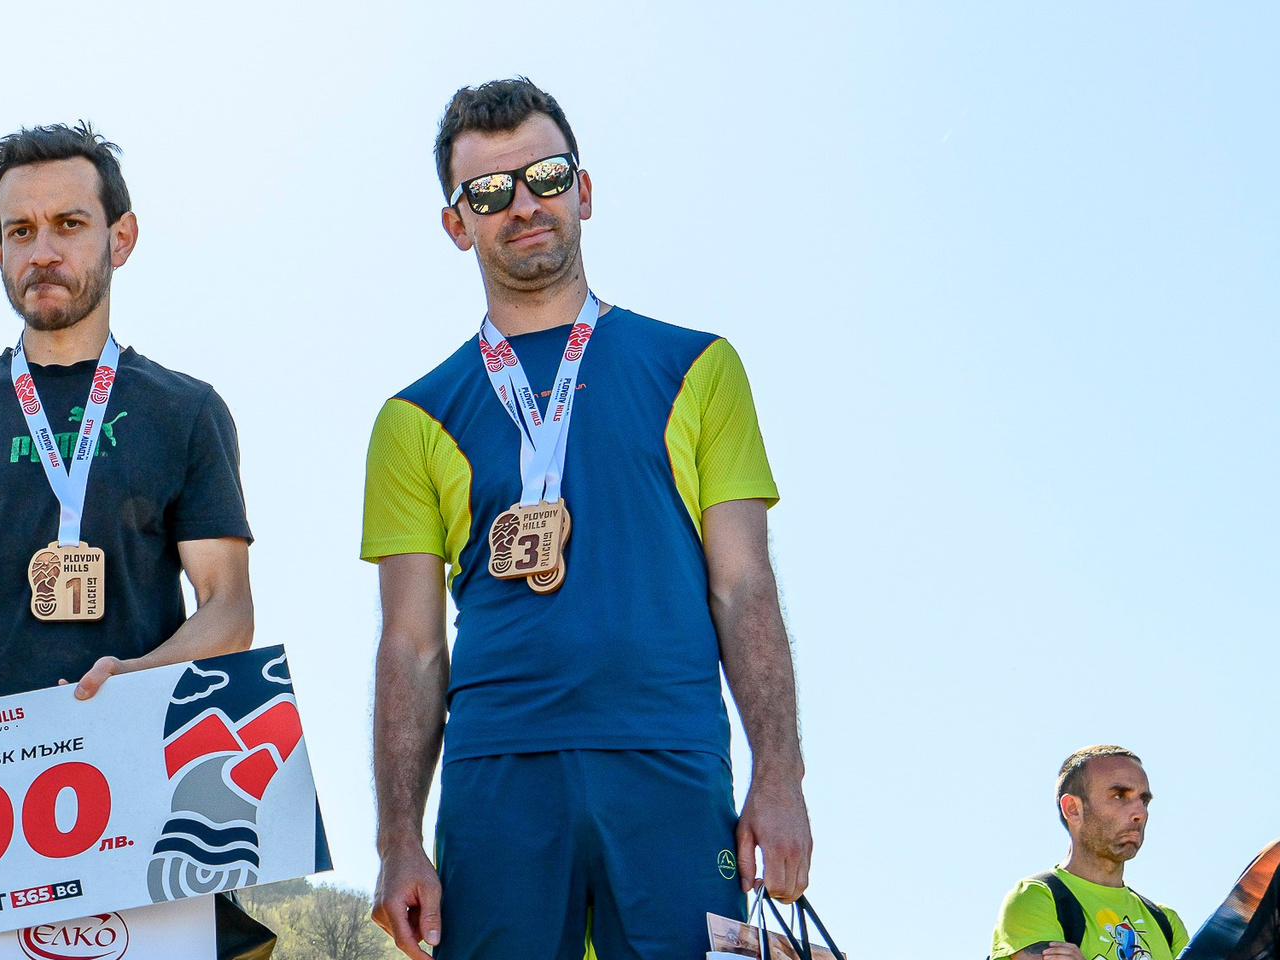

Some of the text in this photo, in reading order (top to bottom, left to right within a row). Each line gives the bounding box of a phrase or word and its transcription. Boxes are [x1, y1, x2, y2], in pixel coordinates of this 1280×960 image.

[553, 405, 564, 422] HILLS
[48, 451, 60, 468] HILLS
[523, 509, 559, 522] PLOVDIV
[522, 520, 547, 531] HILLS
[543, 531, 554, 540] ST
[63, 554, 101, 563] PLOVDIV
[515, 534, 540, 570] 3
[540, 542, 552, 567] PLACE
[63, 564, 89, 573] HILLS
[87, 577, 98, 585] ST
[66, 577, 81, 614] 1
[87, 588, 97, 615] PLACE
[21, 737, 85, 761] МЪЖЕ
